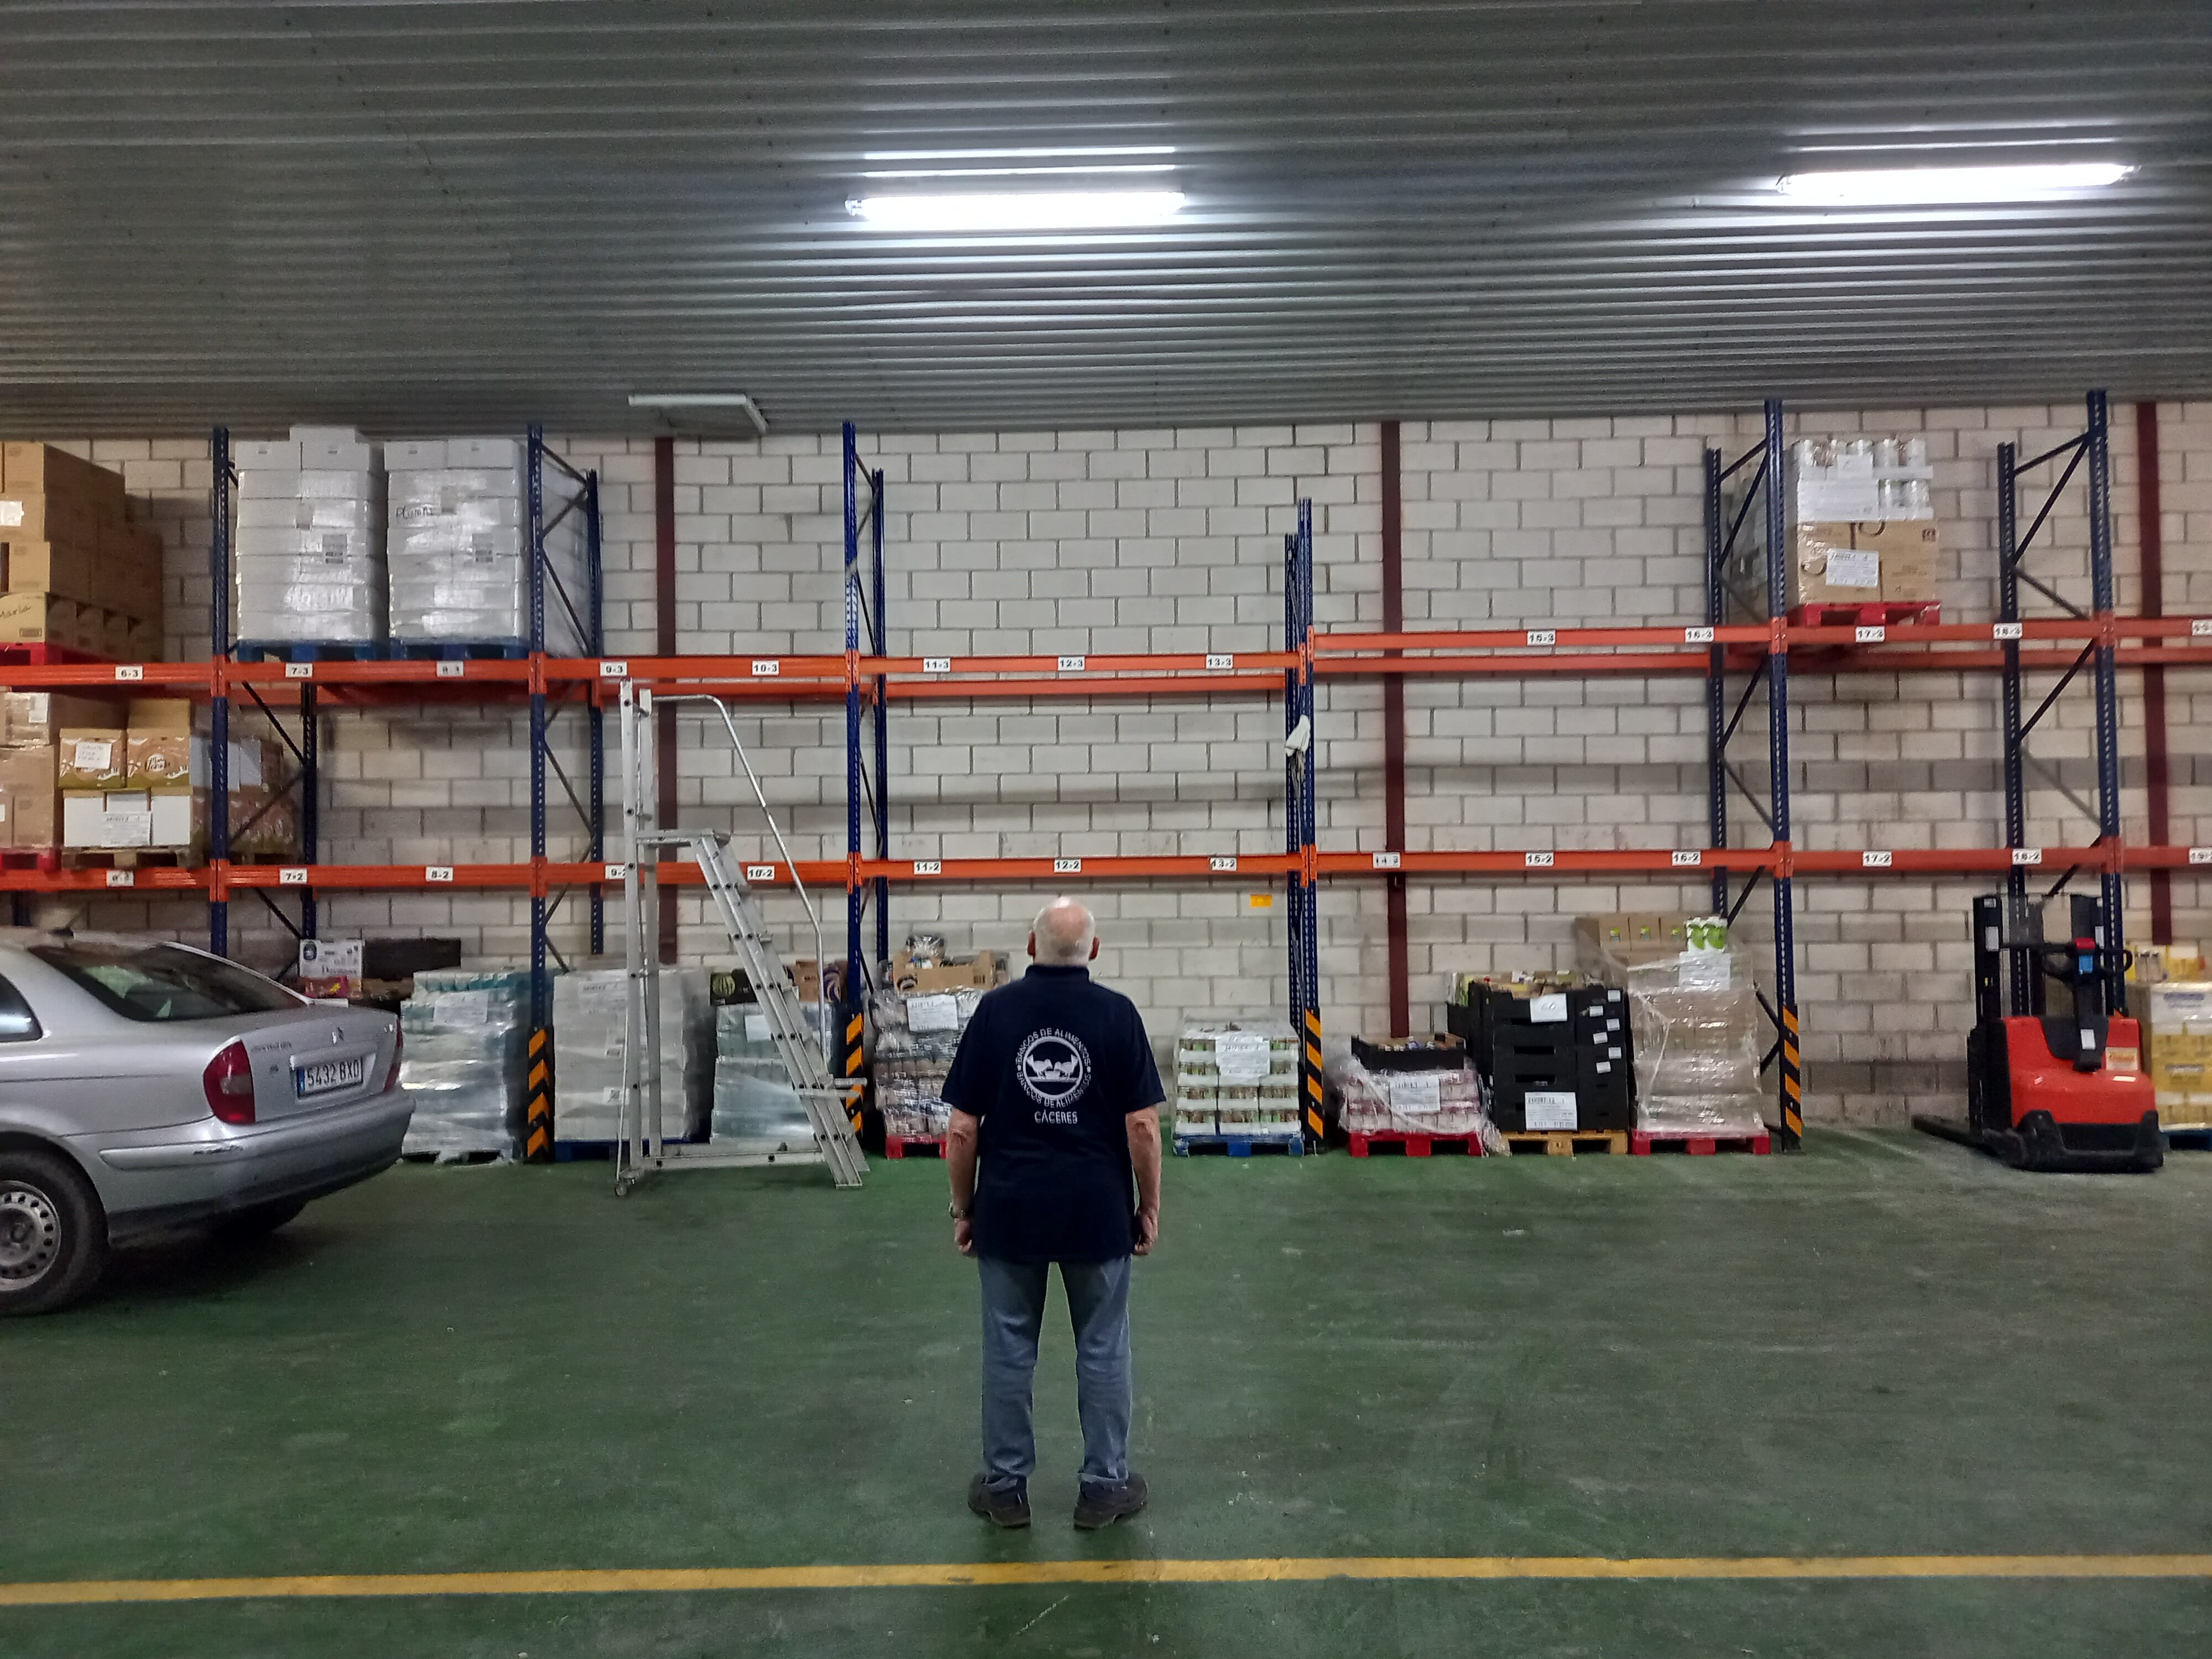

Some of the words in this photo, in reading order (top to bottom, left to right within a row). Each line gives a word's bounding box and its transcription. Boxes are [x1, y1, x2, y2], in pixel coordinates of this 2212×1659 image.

[925, 660, 949, 669] 11-3
[1060, 660, 1083, 668] 12-3
[1208, 658, 1231, 666] 13-3
[754, 664, 777, 672] 10-3
[1527, 854, 1552, 863] 15-2
[1673, 854, 1699, 863] 16-2
[1864, 854, 1891, 863] 17-2
[915, 863, 940, 872] 11-2
[1055, 861, 1079, 869] 12-2
[1211, 859, 1235, 868] 13-2
[749, 869, 773, 877] 10-2
[1040, 1027, 1052, 1036] DE
[306, 1063, 336, 1087] 5432
[1044, 1097, 1055, 1108] DE
[1034, 1109, 1078, 1124] CÁCERES
